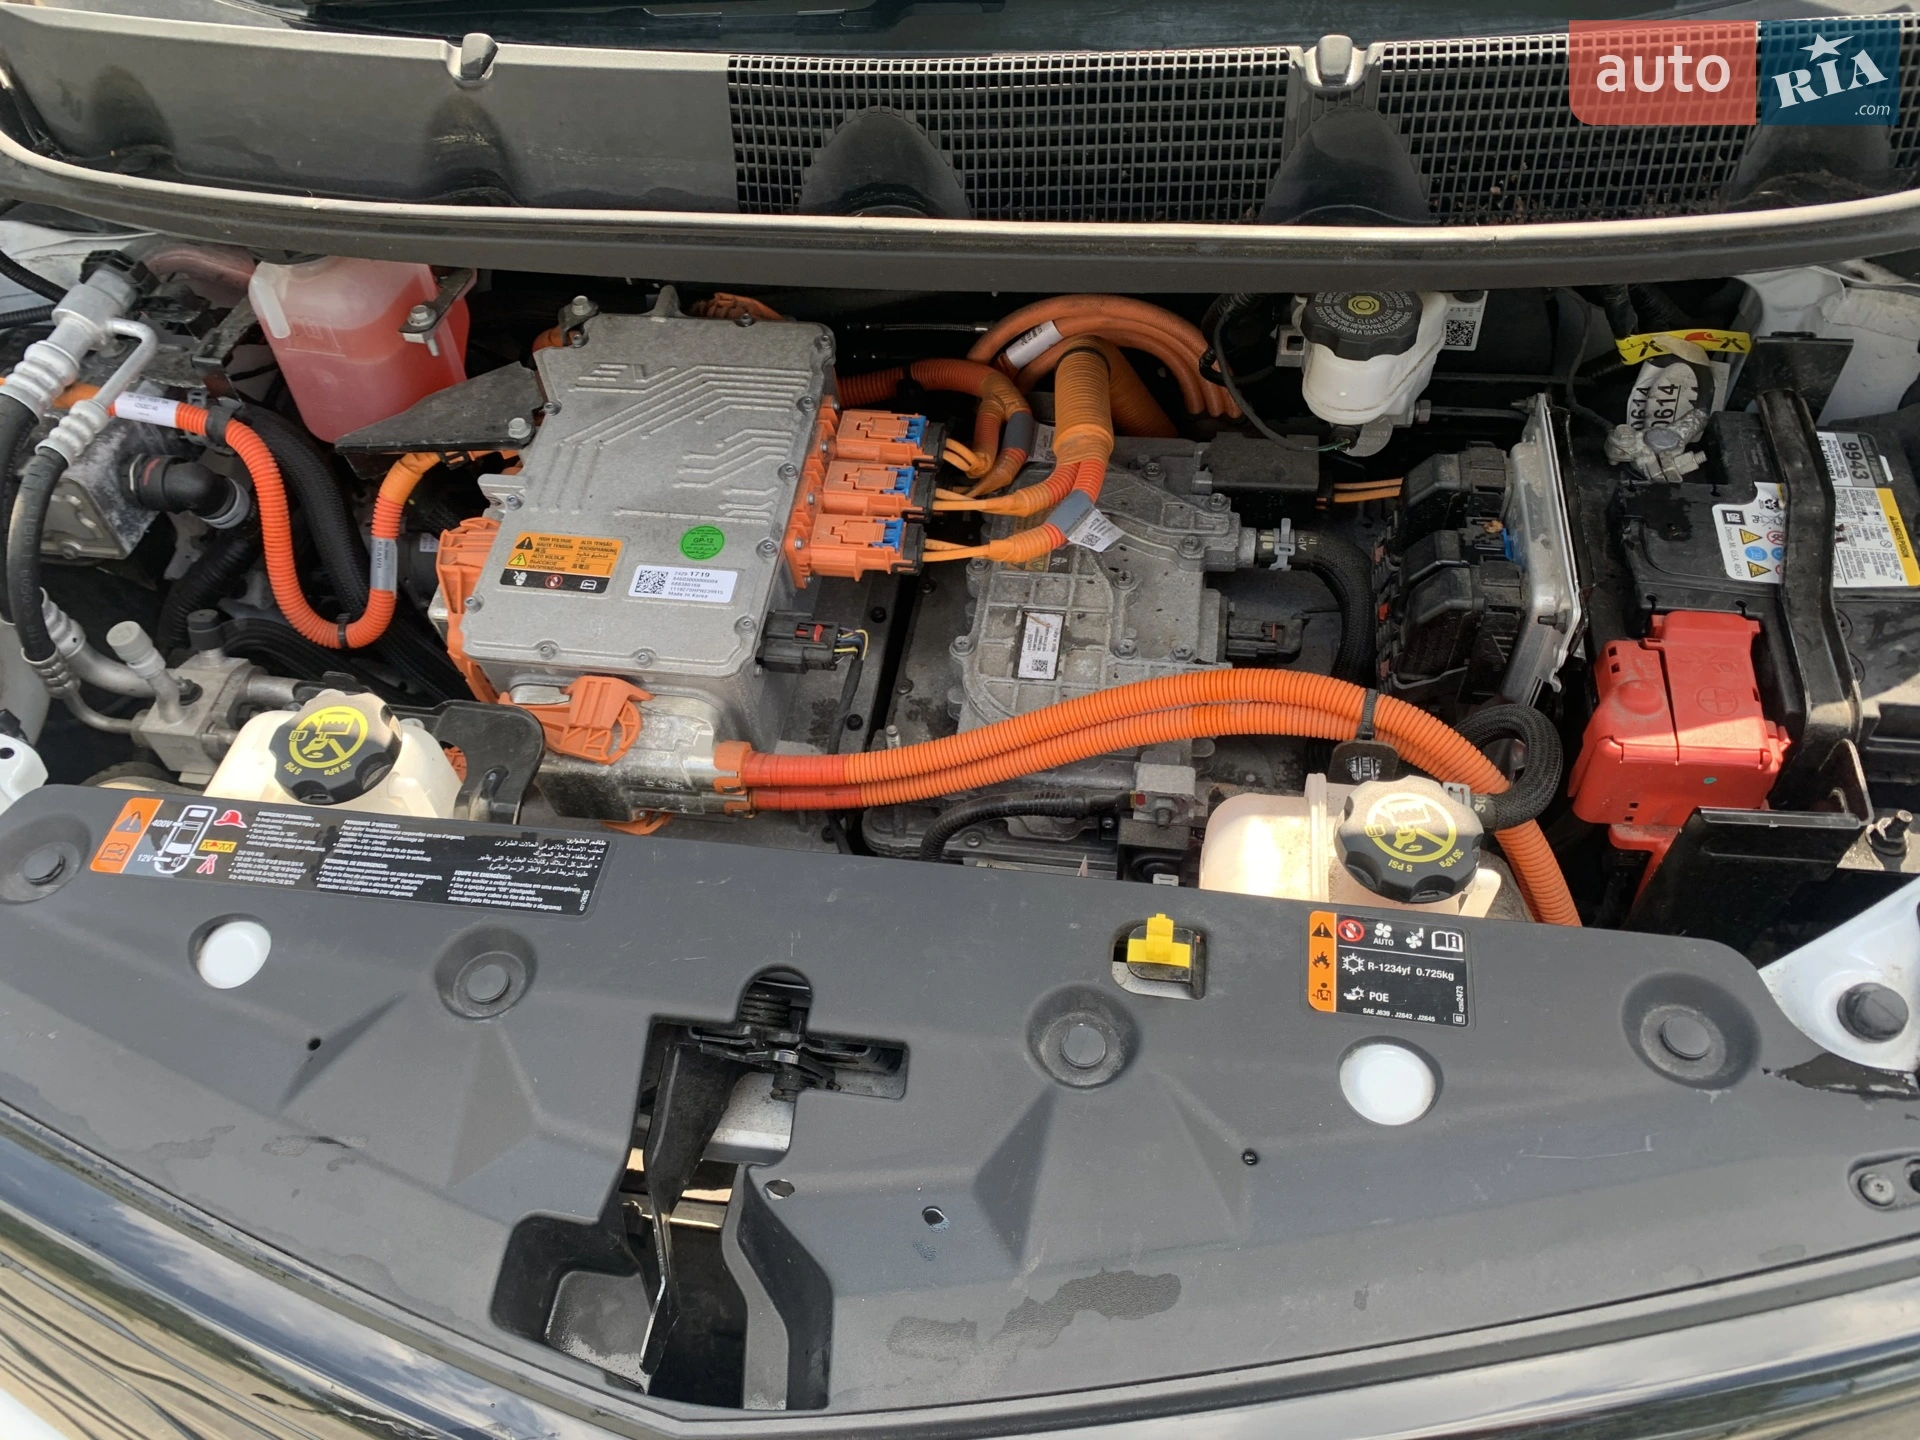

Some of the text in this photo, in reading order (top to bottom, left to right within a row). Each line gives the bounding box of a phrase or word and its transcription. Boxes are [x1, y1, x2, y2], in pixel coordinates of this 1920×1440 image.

[1842, 443, 1869, 479] 9943
[1751, 514, 1760, 524] Pb
[284, 761, 296, 773] PSI
[323, 761, 352, 776] 35 kPa
[151, 819, 173, 828] 400V
[137, 854, 154, 862] 12V
[1438, 848, 1464, 868] 35 kPa
[1387, 859, 1413, 873] 5 PSI
[1372, 937, 1394, 947] AUTO
[1367, 961, 1455, 981] R-1234yf 0.725kg
[1369, 991, 1390, 1002] POE
[1394, 1012, 1413, 1020] J2842
